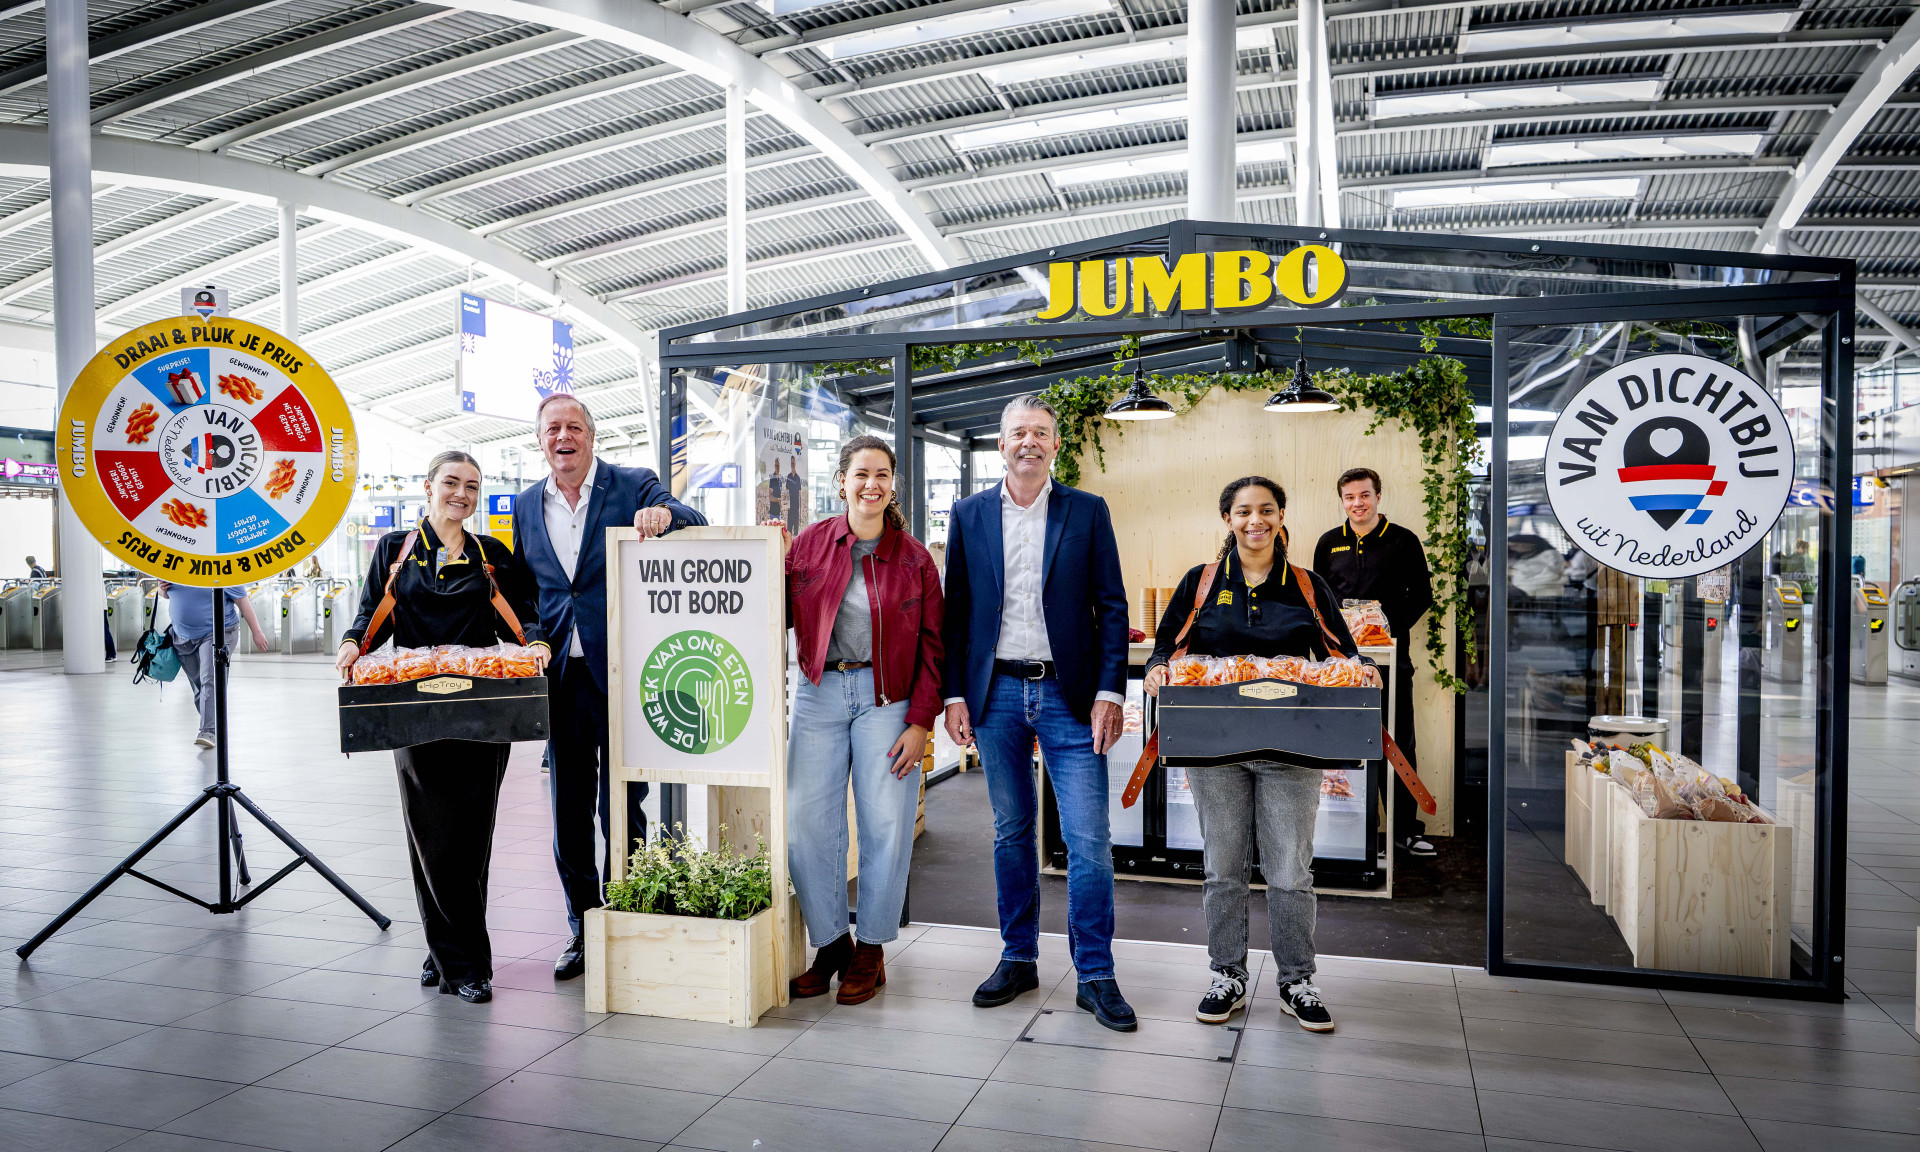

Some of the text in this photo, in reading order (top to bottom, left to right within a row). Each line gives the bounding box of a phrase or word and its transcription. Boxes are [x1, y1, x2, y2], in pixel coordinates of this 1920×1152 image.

[1036, 244, 1349, 322] JUMBO
[114, 326, 304, 375] DRAAI & PLUK JE PRIJS
[157, 357, 191, 373] SURPRISE!
[229, 357, 269, 378] GEWONNEN!
[106, 396, 128, 433] GEWONNEN!
[283, 402, 293, 415] NET
[288, 414, 298, 424] DE
[294, 405, 312, 434] JAMMER!
[1558, 367, 1779, 486] VAN DICHTBIJ
[70, 418, 86, 478] JUMBO
[164, 415, 192, 485] uit Nederland
[203, 409, 257, 493] VAN DICHTBIJ
[330, 426, 344, 482] JUMBO
[109, 469, 129, 499] JAMMER!
[124, 478, 134, 490] DE
[129, 490, 140, 502] NET
[294, 468, 314, 504] GEWONNEN!
[155, 525, 196, 545] GEWONNEN!
[236, 528, 268, 545] JAMMER!
[249, 524, 257, 532] DE
[258, 518, 270, 529] NET
[1576, 509, 1758, 567] uit Nederland
[117, 530, 306, 576] DRAAI & PLUK JE PRIJS
[1331, 545, 1350, 554] JUMBO
[638, 559, 752, 583] VAN GROND
[647, 590, 744, 615] TOT BORD
[644, 635, 749, 748] DE WEEK VAN ONS ETEN
